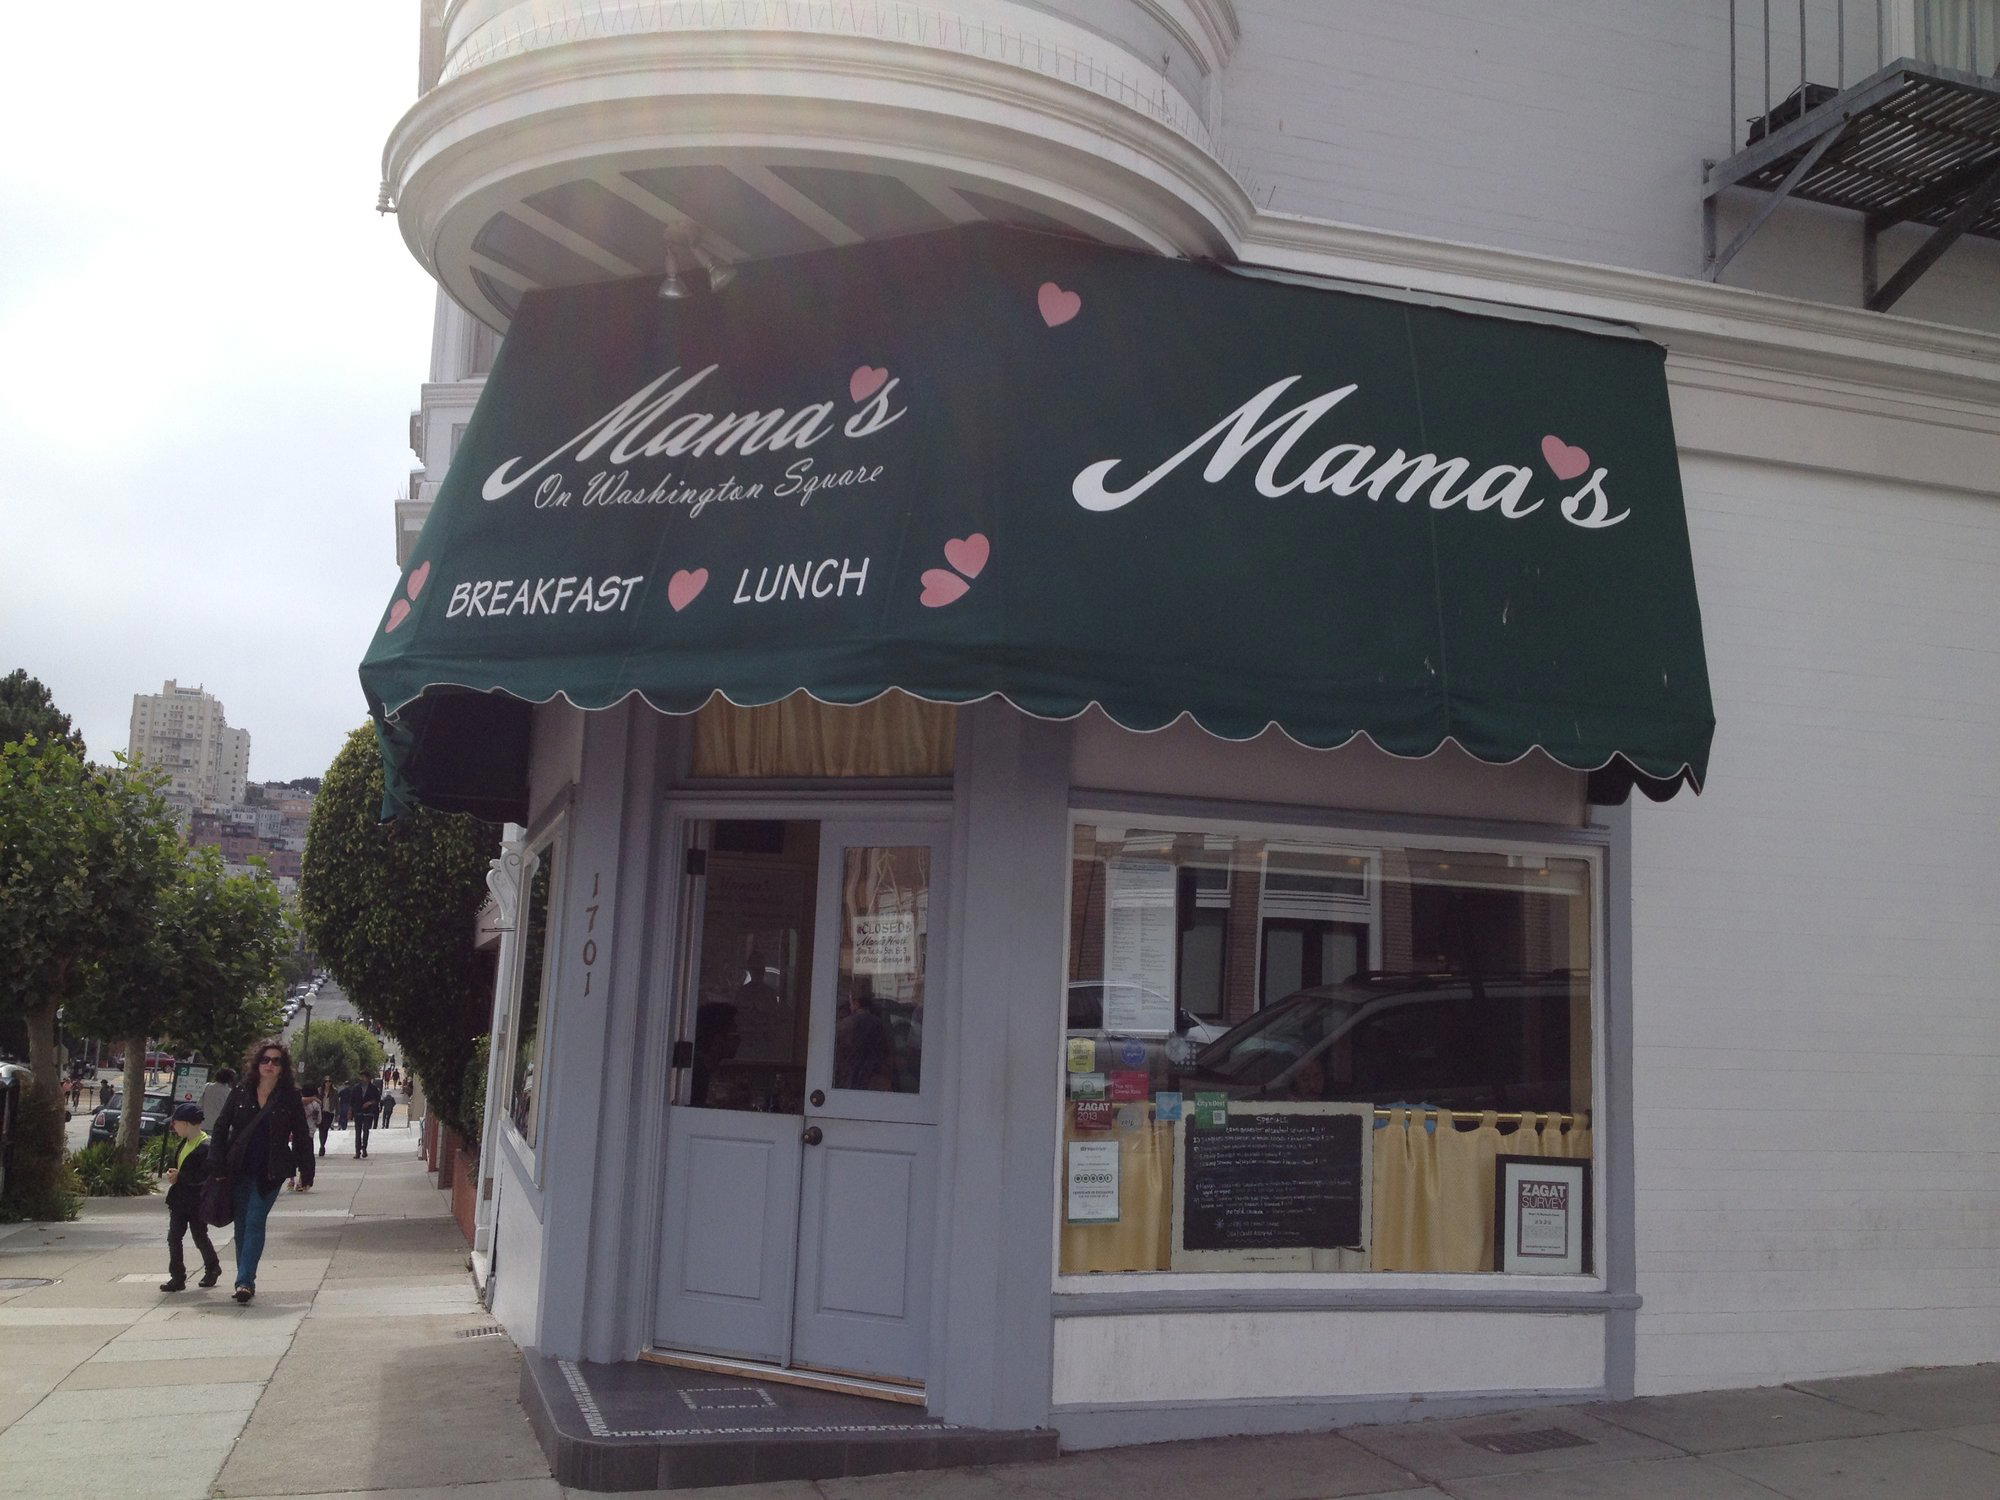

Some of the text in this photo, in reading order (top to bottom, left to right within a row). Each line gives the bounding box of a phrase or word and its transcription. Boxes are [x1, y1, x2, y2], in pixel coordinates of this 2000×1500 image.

[534, 458, 884, 519] On Washington Square
[446, 557, 870, 618] BREAKFAST LUNCH
[583, 872, 601, 998] 1701
[862, 923, 904, 934] CLOSED
[1077, 1102, 1110, 1111] ZAGAT
[1077, 1112, 1098, 1121] 2013
[1522, 1184, 1566, 1198] ZAGAT
[1521, 1196, 1566, 1209] SURVEY
